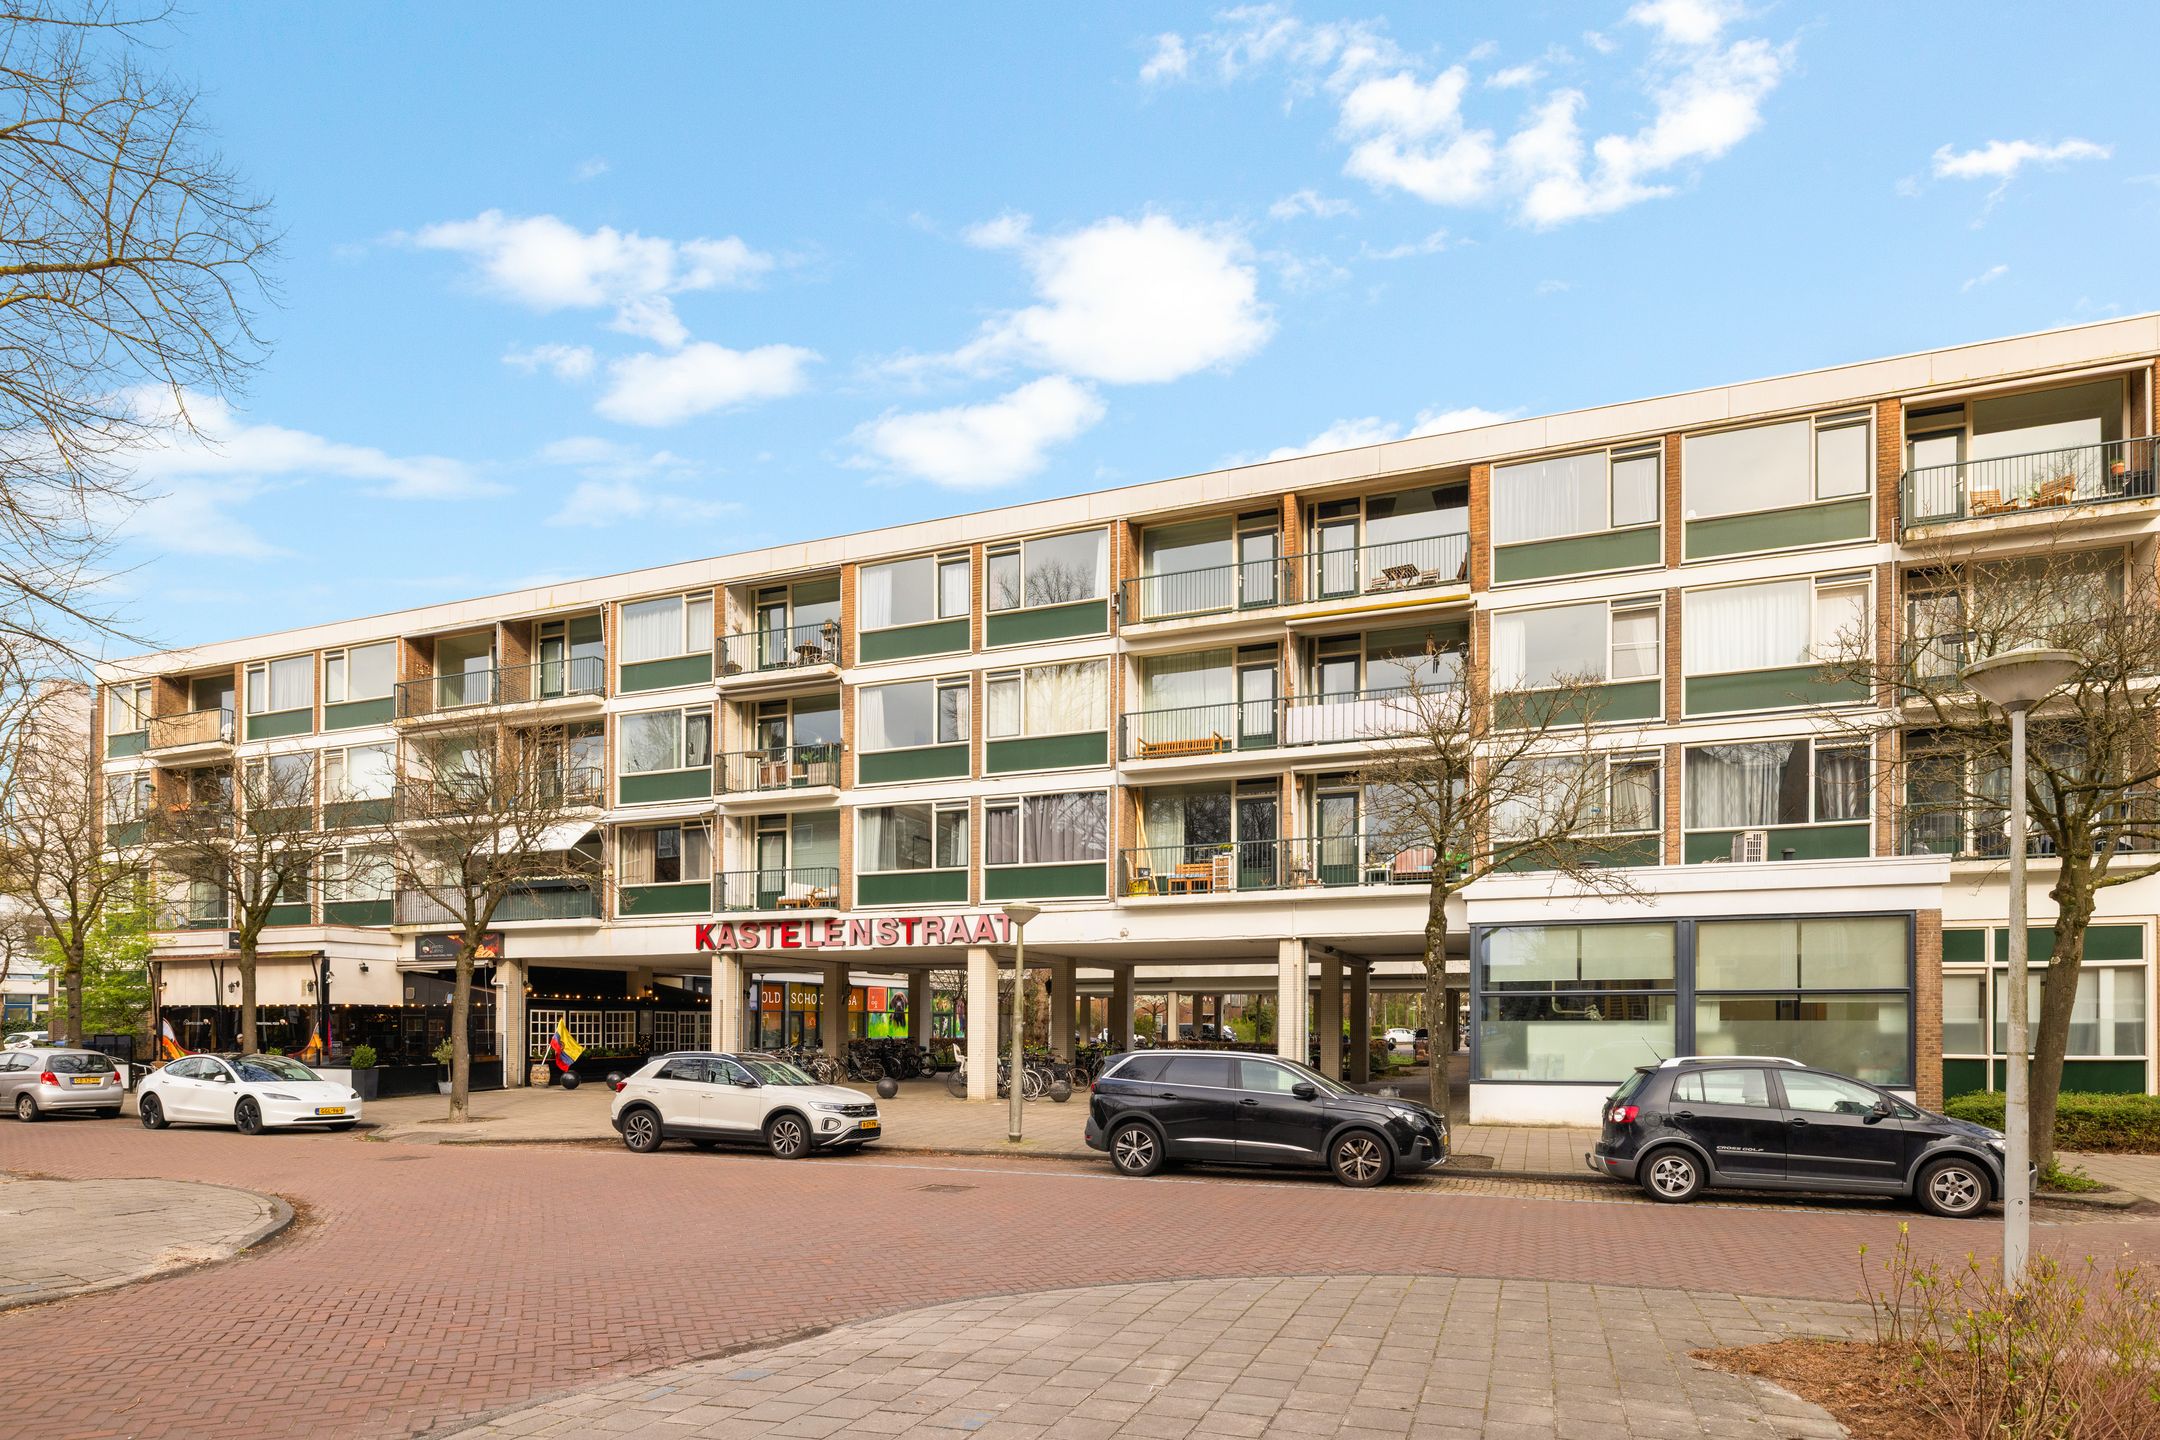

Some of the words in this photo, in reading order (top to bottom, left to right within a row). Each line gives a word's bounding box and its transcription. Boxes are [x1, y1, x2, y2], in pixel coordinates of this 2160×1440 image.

[695, 914, 1011, 950] KASTELENSTRAAT
[761, 992, 781, 1004] OLD
[790, 992, 825, 1005] SCHOO
